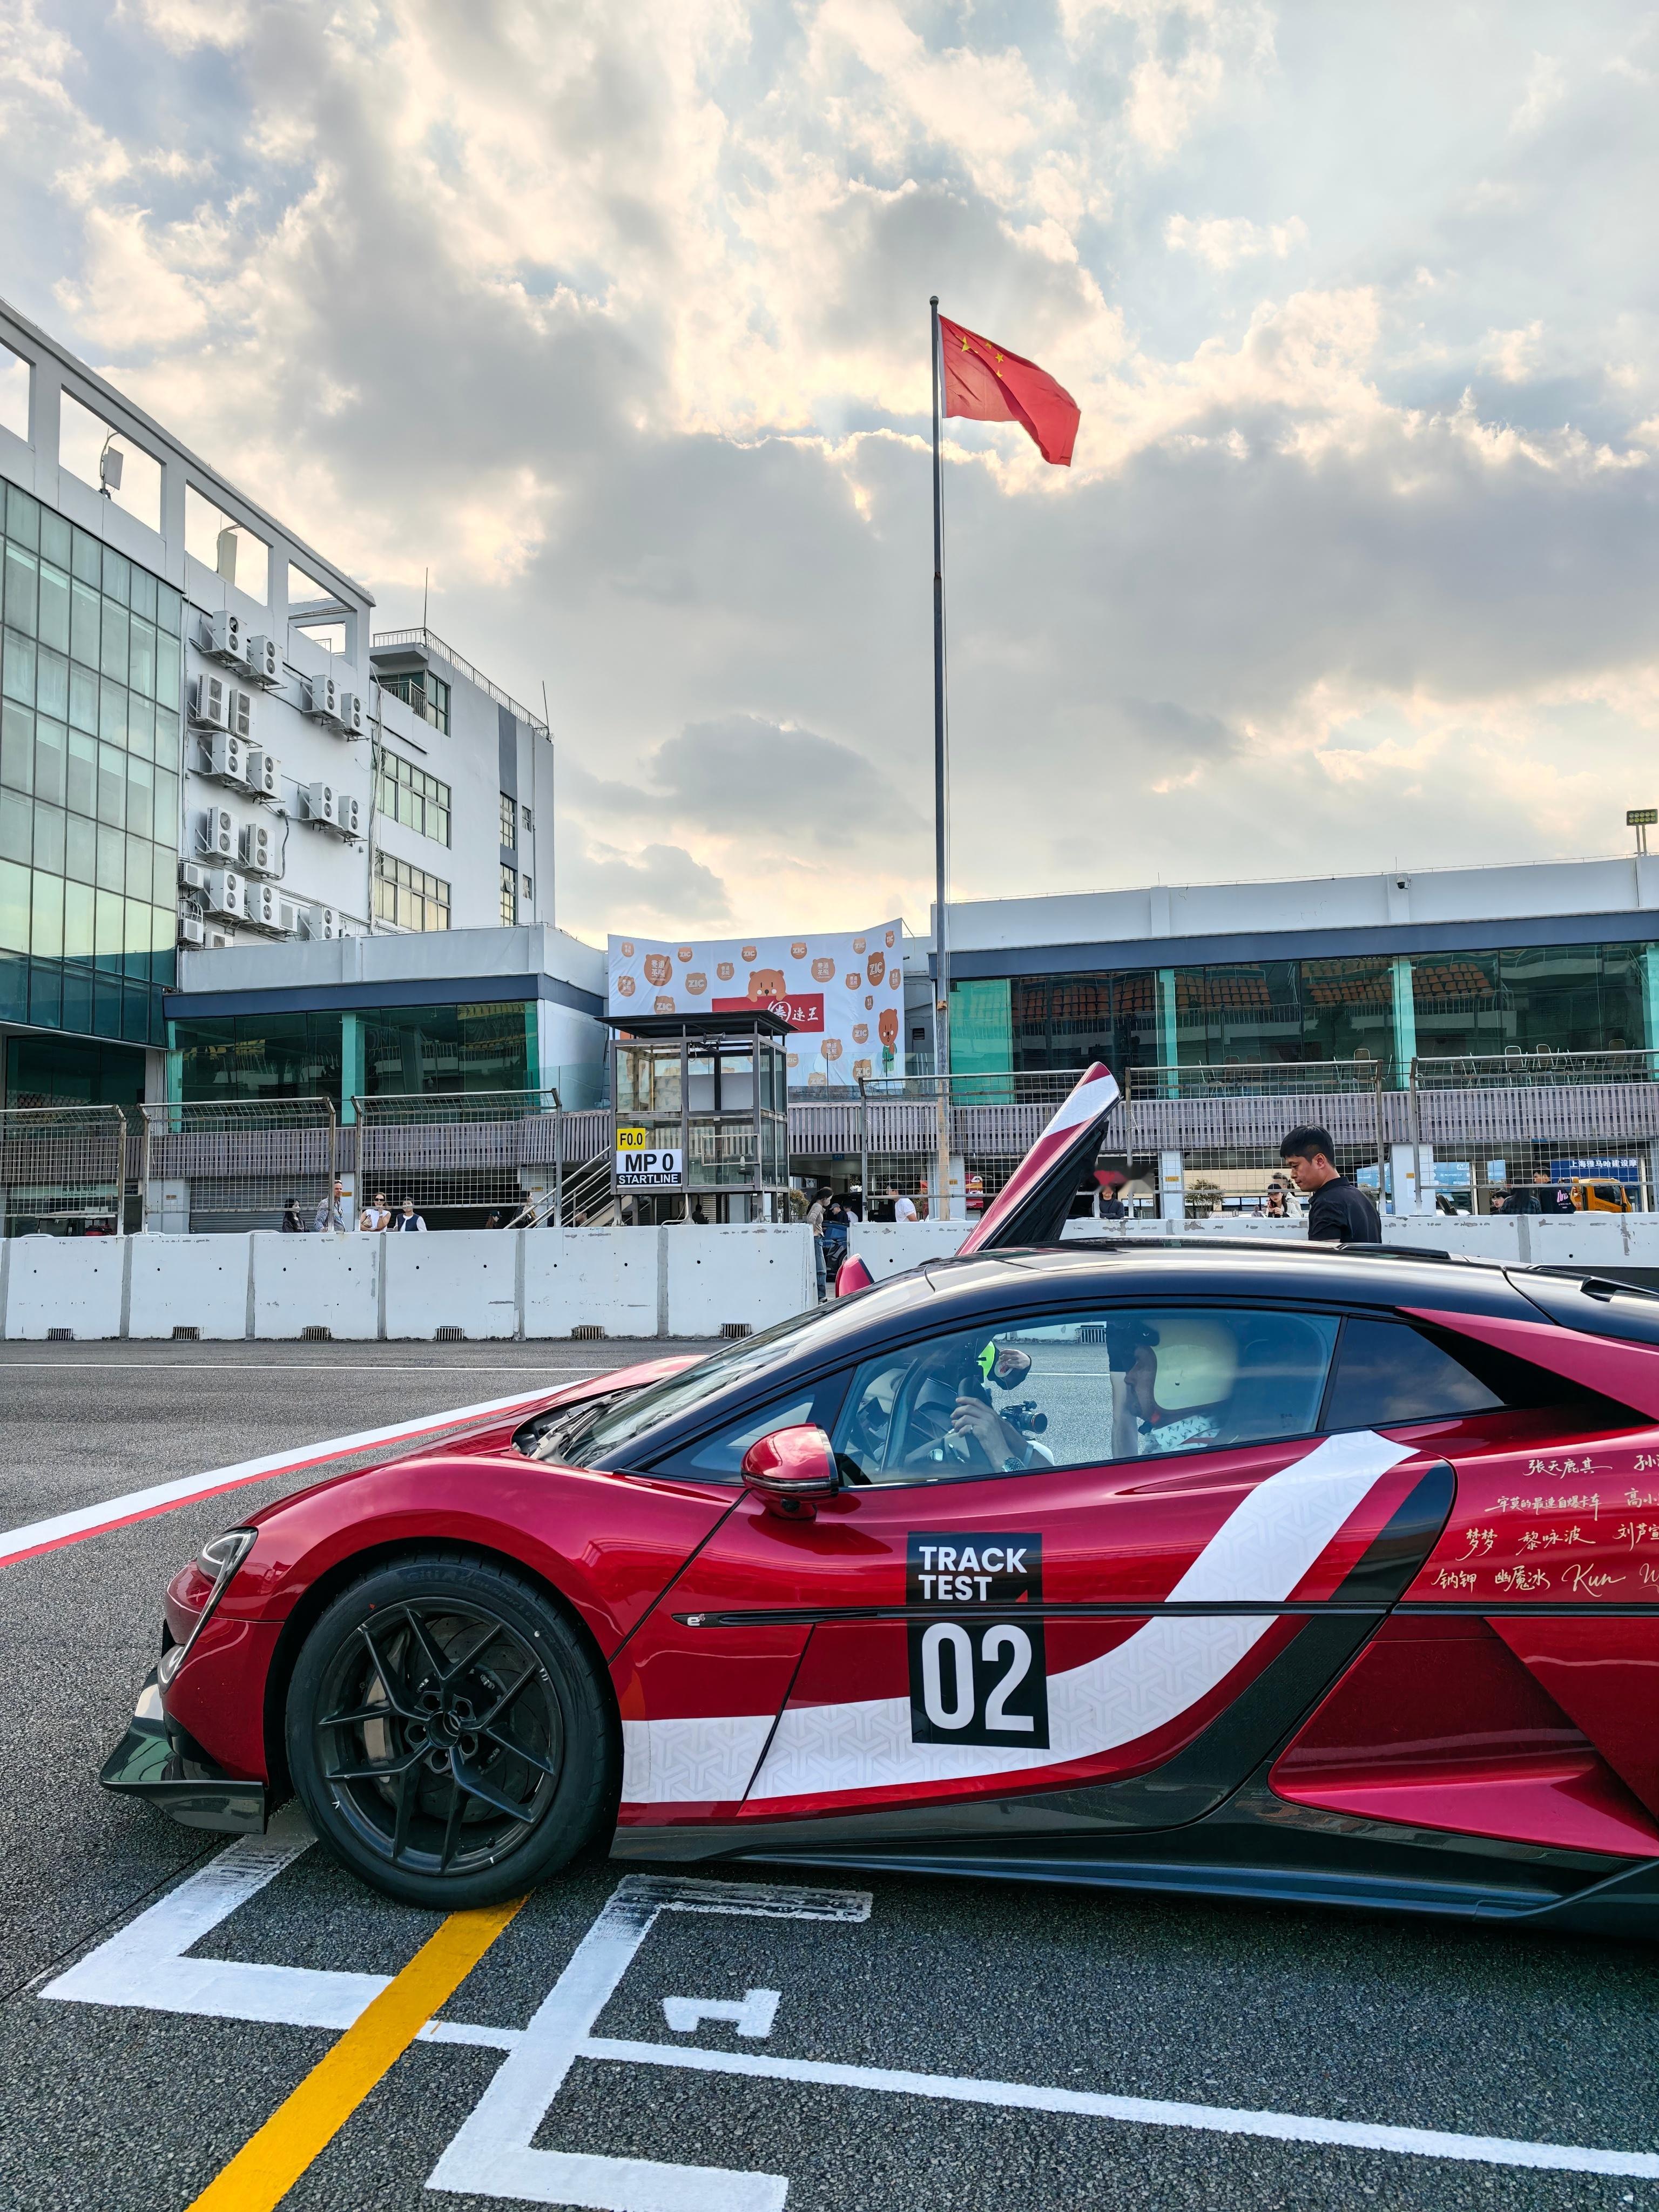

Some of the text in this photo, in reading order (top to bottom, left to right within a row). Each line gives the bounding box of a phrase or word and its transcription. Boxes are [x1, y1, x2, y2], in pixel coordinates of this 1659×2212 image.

[869, 962, 883, 975] ZIC
[688, 979, 705, 988] ZIC
[656, 1002, 673, 1011] ZIC
[855, 1029, 867, 1037] ZIC
[855, 1067, 871, 1076] ZIC
[620, 1132, 643, 1145] F0.0
[625, 1153, 673, 1172] MP 0
[618, 1174, 678, 1184] STARTLINE
[1624, 1487, 1659, 1508] 高小
[1455, 1528, 1498, 1561] 梦梦
[919, 1546, 1028, 1573] TRACK
[919, 1575, 993, 1601] TEST
[1561, 1563, 1627, 1597] Kun
[921, 1622, 1035, 1732] 02
